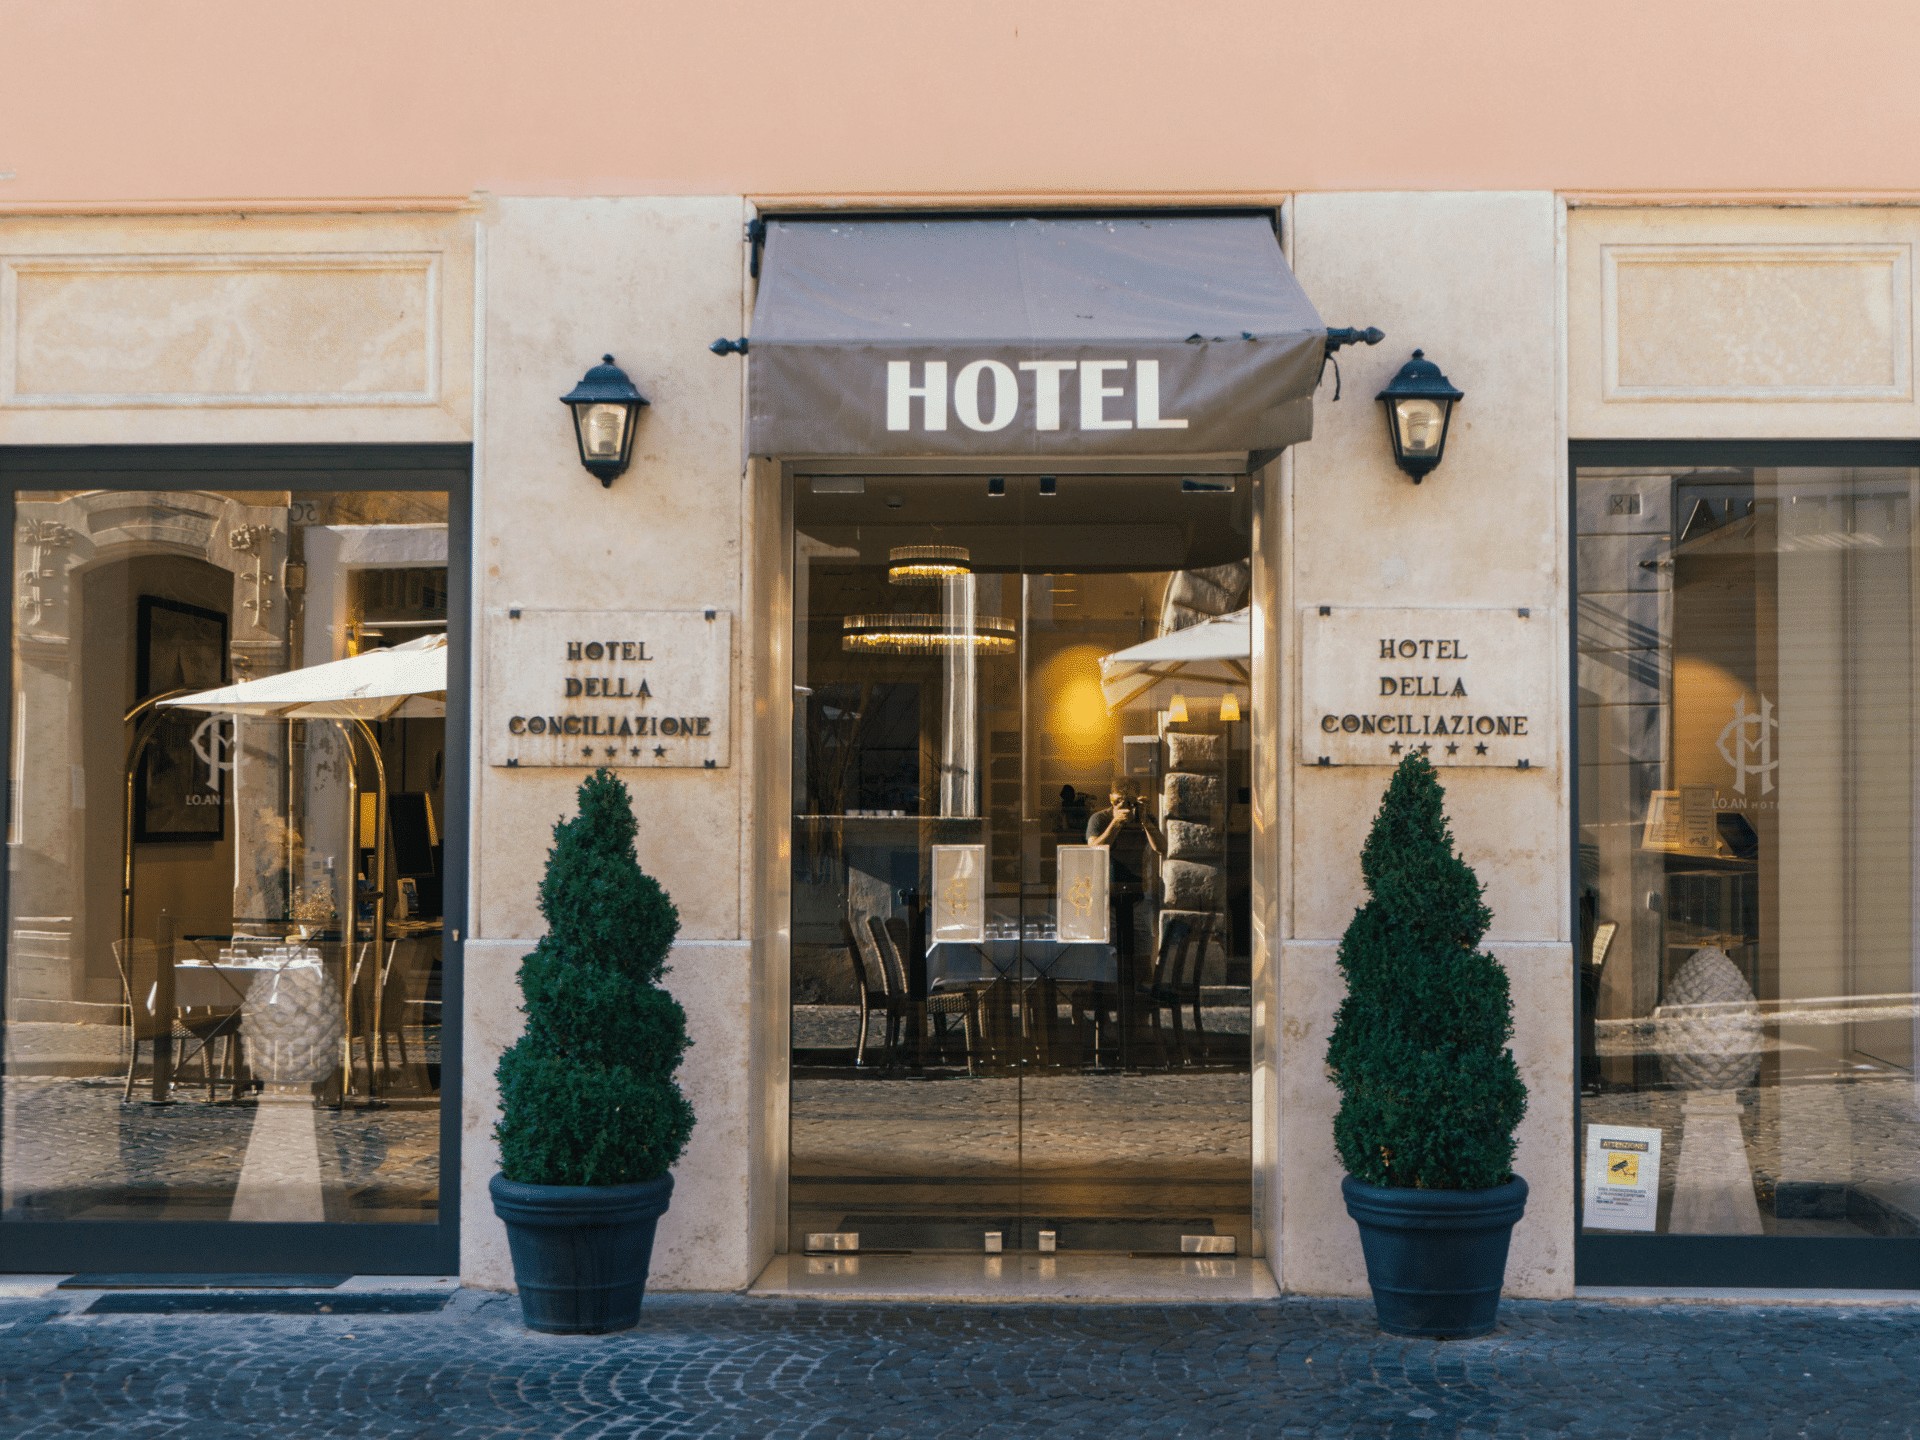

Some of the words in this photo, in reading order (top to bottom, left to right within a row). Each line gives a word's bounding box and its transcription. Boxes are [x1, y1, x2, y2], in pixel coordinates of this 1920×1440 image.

[887, 359, 1189, 432] HOTEL
[566, 641, 654, 661] HOTEL
[1379, 639, 1468, 660] HOTEL
[565, 677, 653, 698] DELLA
[1379, 676, 1468, 697] DELLA
[508, 715, 711, 737] CONCILIAZIONE
[1321, 714, 1529, 736] CONCILIAZIONE
